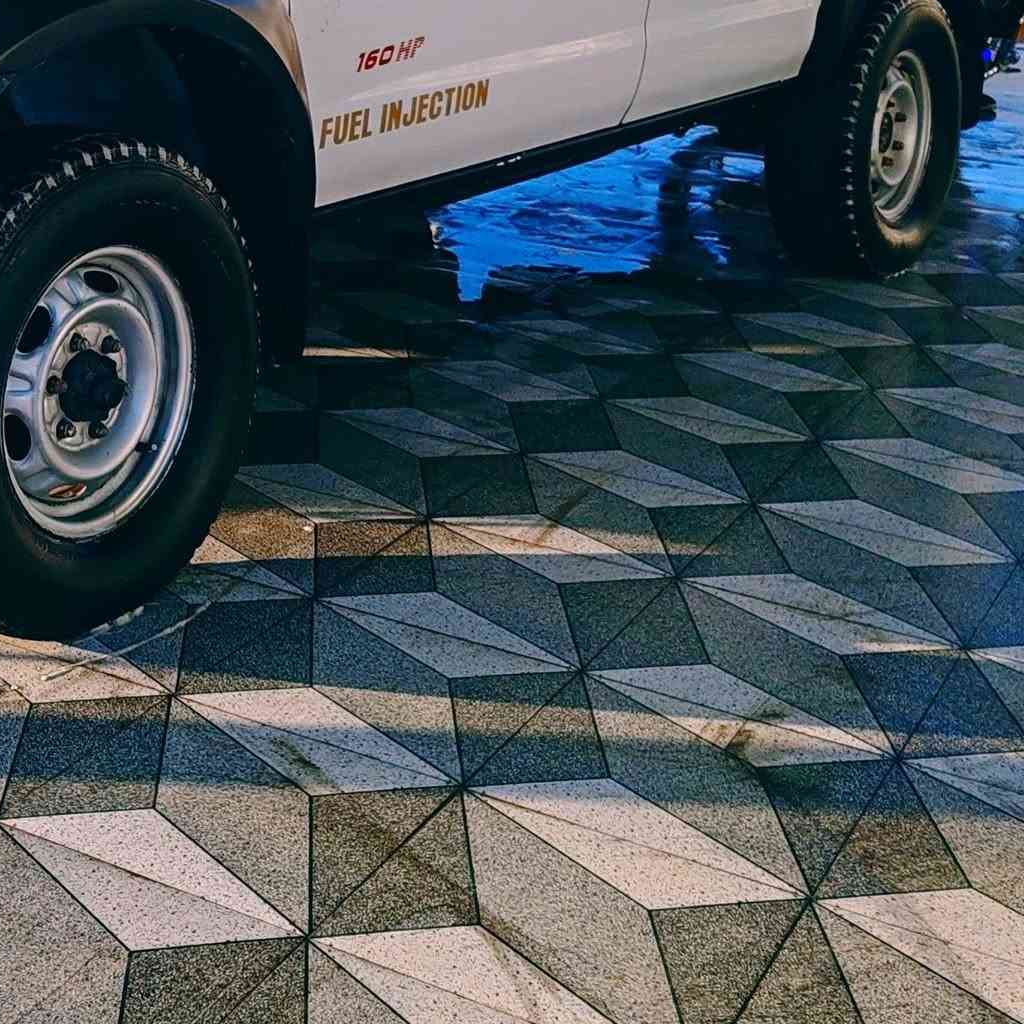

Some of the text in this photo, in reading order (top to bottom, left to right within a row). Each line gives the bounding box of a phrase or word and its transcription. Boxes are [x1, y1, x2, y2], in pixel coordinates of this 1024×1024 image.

[357, 36, 425, 73] 160 HP
[319, 78, 490, 150] FUEL INJECTION
